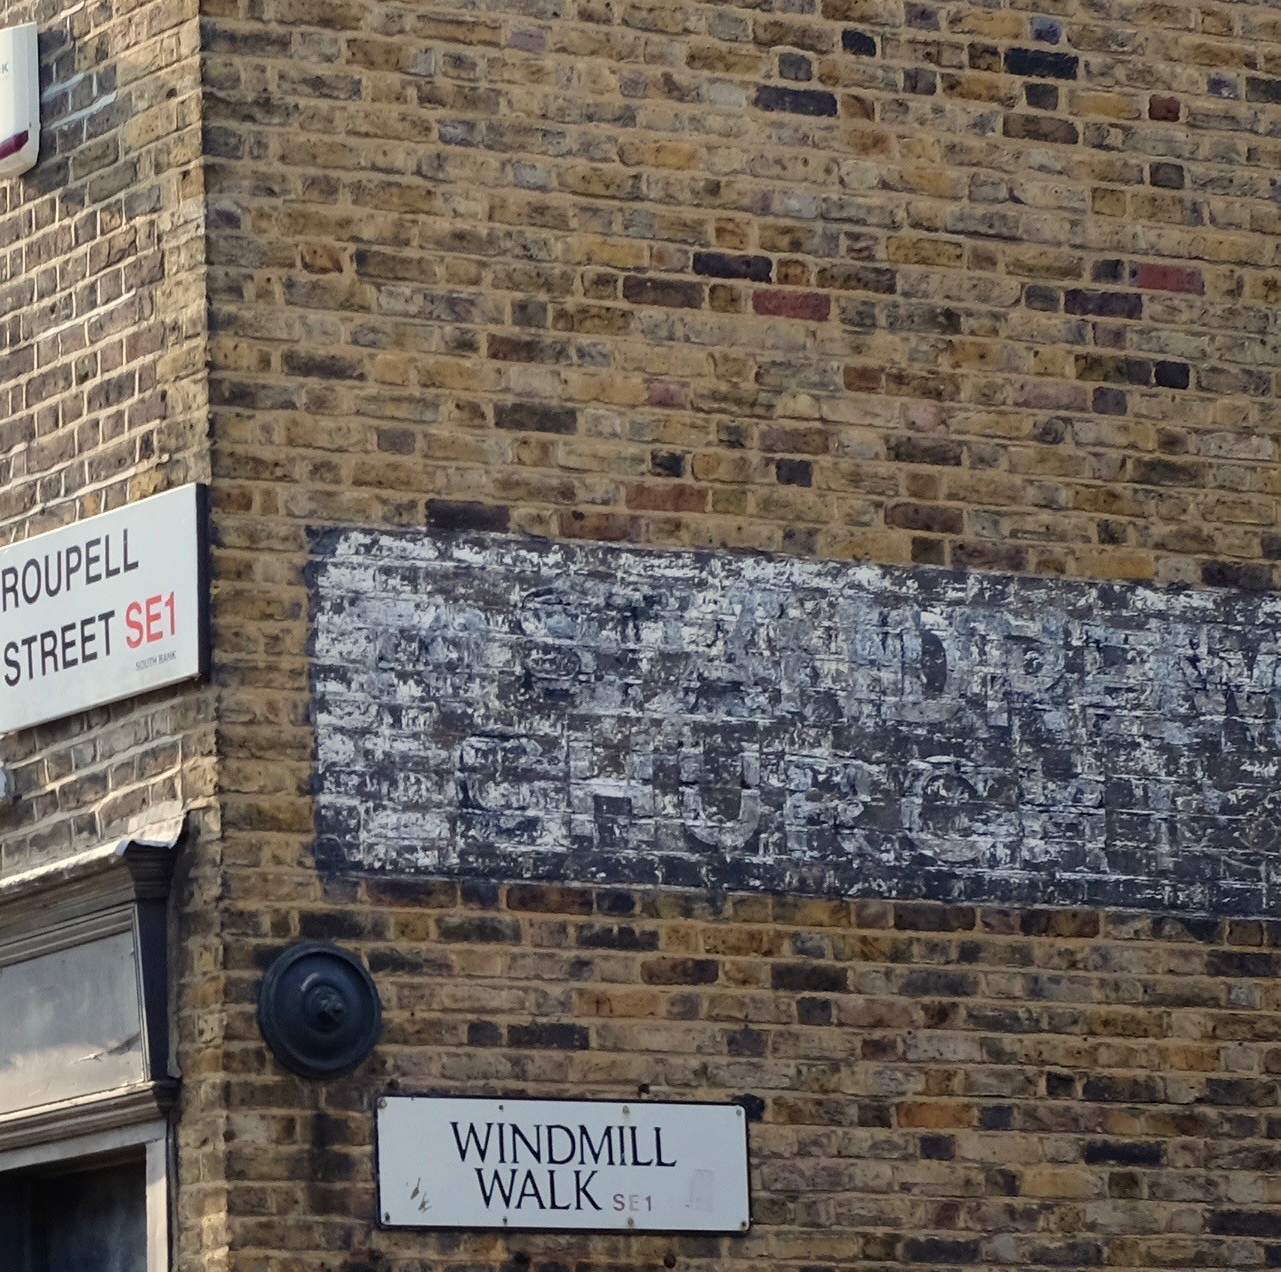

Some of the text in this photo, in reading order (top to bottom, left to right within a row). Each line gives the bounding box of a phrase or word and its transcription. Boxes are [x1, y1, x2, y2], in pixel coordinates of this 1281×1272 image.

[1, 528, 139, 612] ROUPELL
[4, 591, 176, 686] STREET SE1
[449, 1121, 678, 1167] WINDMILL
[473, 1167, 653, 1212] WALK SE1
